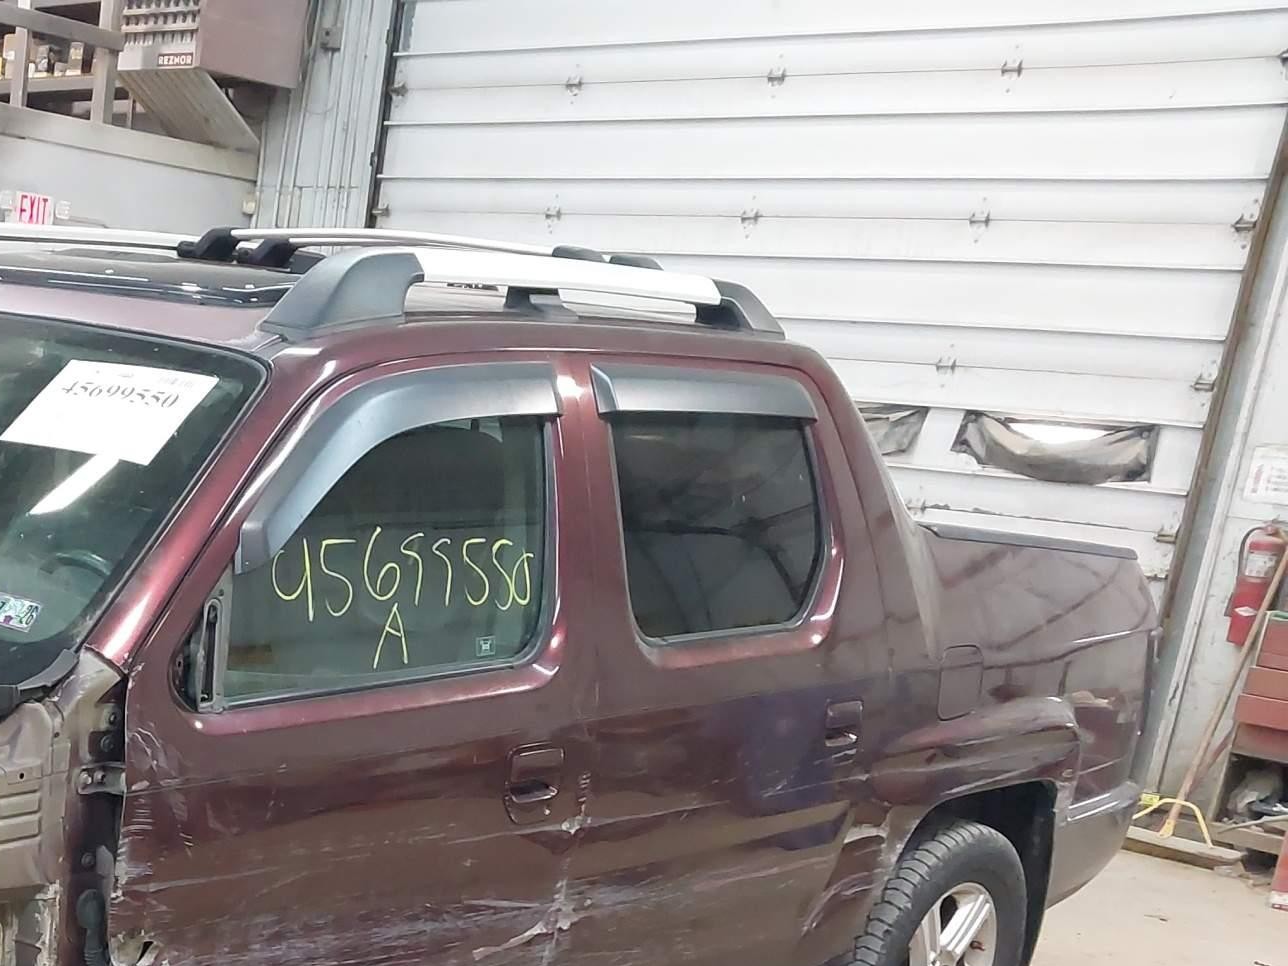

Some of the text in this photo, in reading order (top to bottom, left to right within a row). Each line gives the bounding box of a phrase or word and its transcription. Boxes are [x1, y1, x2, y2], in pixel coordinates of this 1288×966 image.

[158, 55, 193, 65] REZNOR
[18, 194, 49, 225] EXIT
[61, 380, 180, 408] 45699550
[372, 602, 409, 669] A
